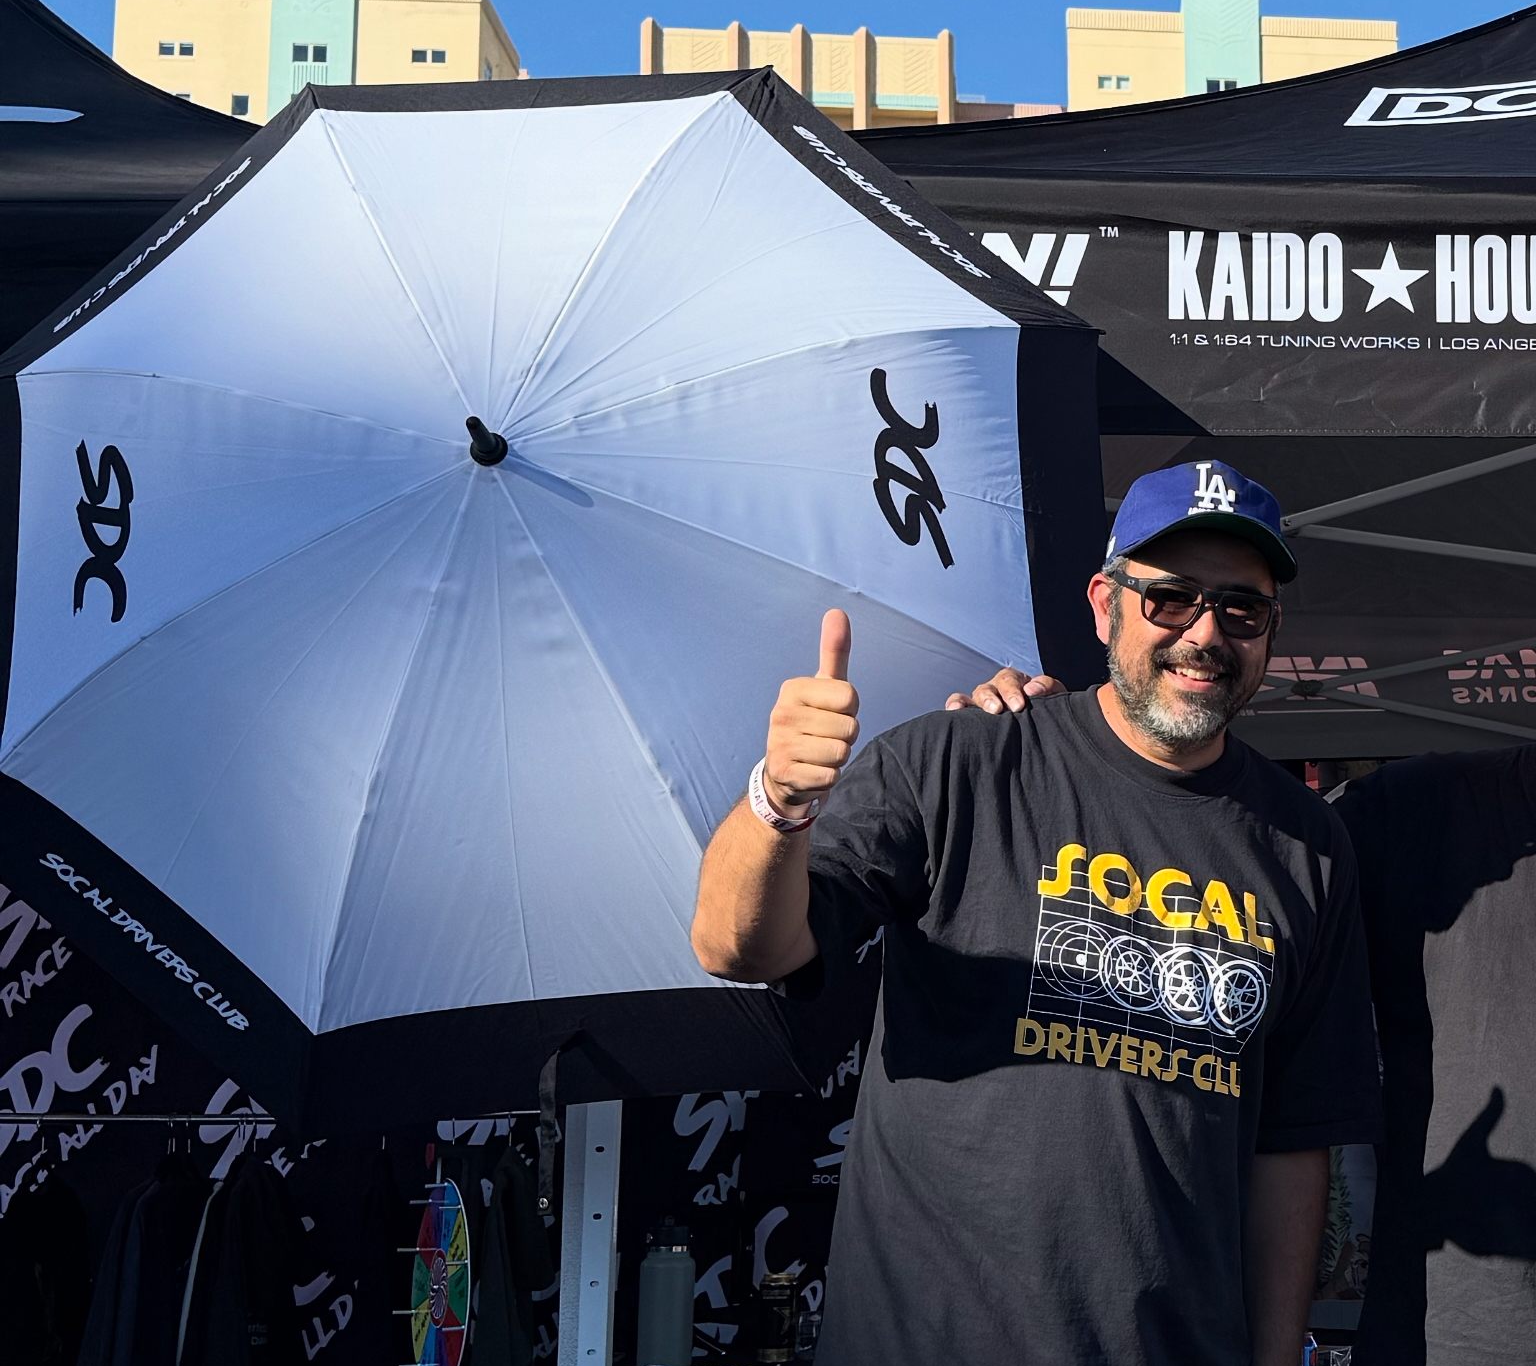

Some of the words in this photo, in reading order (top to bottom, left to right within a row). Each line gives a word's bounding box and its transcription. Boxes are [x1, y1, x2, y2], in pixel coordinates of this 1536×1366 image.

[1168, 231, 1343, 322] KAIDO
[1213, 334, 1251, 346] 1:64
[1256, 335, 1336, 348] TUNING
[1340, 336, 1420, 350] WORKS
[1440, 338, 1480, 350] LOS
[1194, 463, 1236, 513] LA
[1037, 843, 1275, 954] SOCAL
[39, 852, 112, 916] SOCAL
[109, 907, 200, 985] DRIVERS
[192, 981, 251, 1032] CLUB
[1013, 1017, 1188, 1082] DRIVERS
